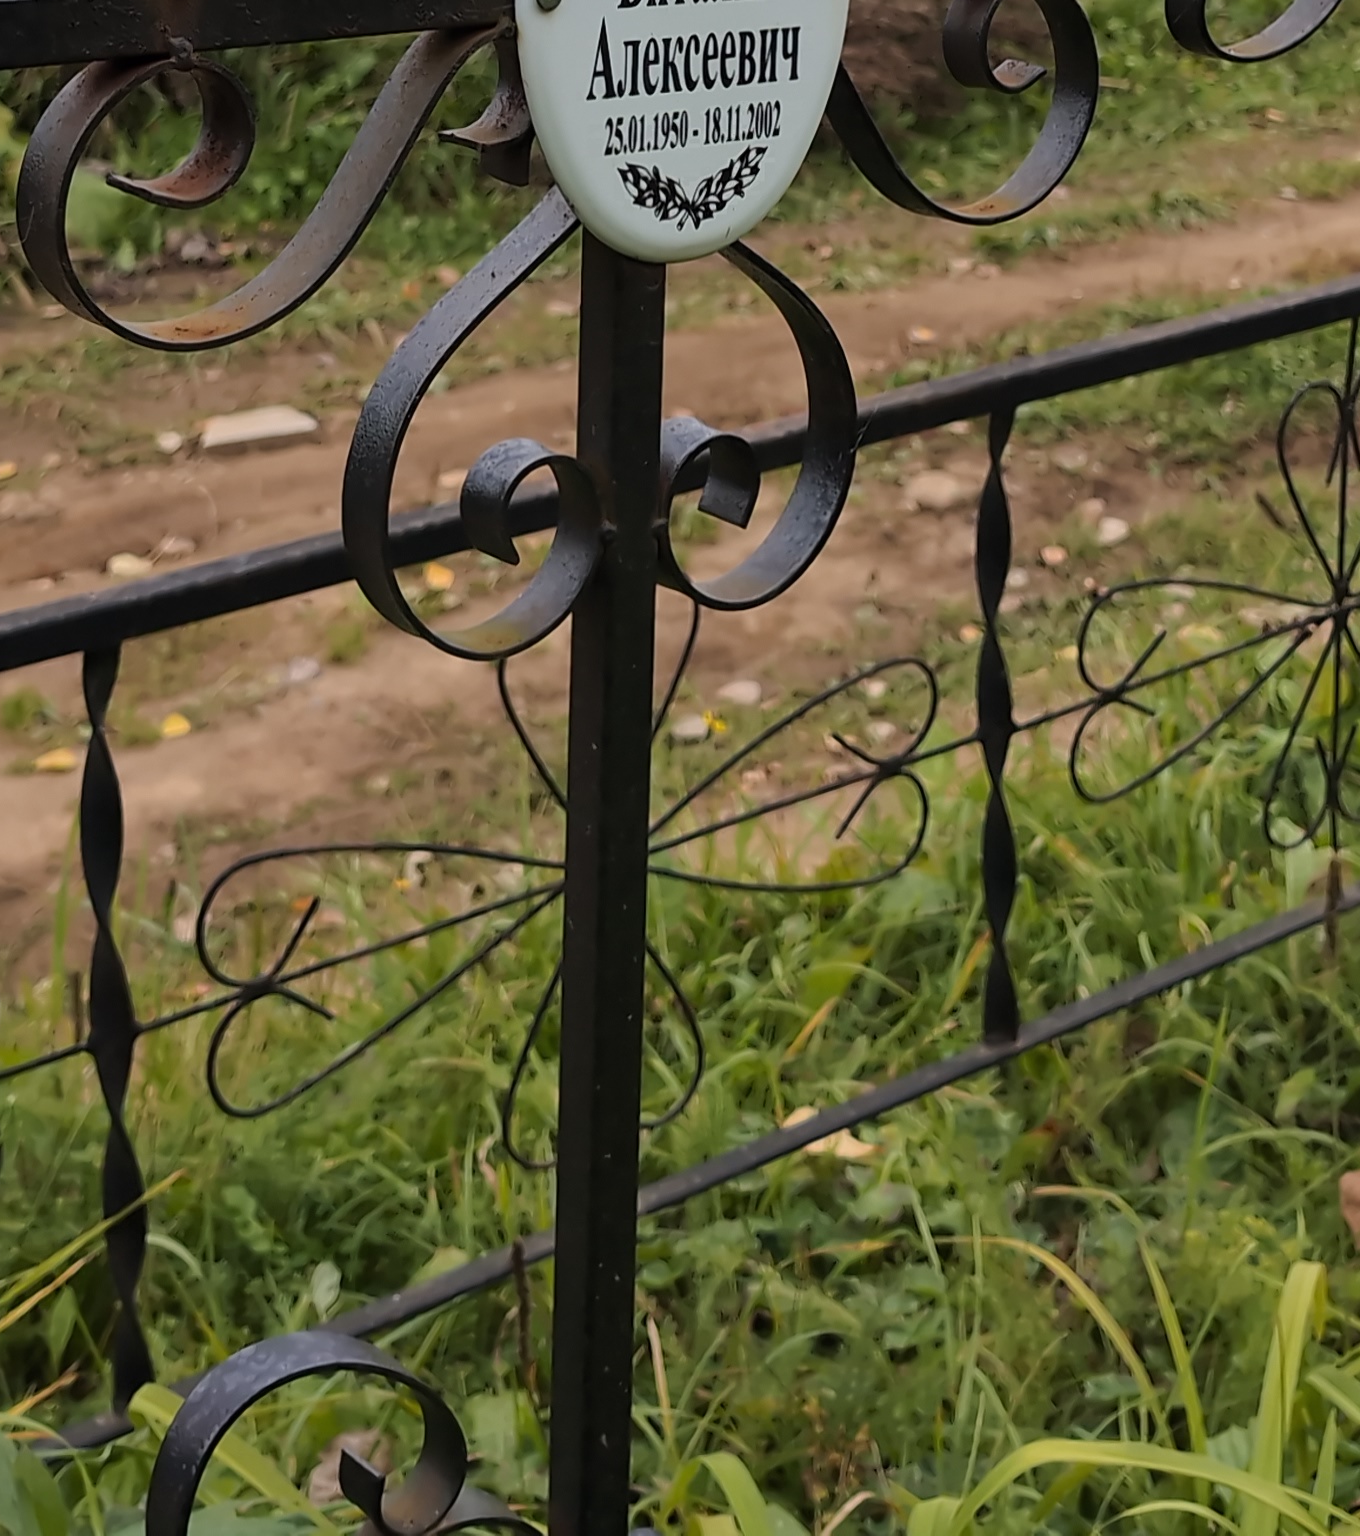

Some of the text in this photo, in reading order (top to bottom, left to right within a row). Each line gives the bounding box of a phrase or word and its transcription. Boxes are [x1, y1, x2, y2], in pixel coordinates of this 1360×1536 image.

[586, 17, 801, 102] Алексеевич
[604, 110, 688, 156] 25.01.1950
[703, 100, 780, 145] 18.11.2002
